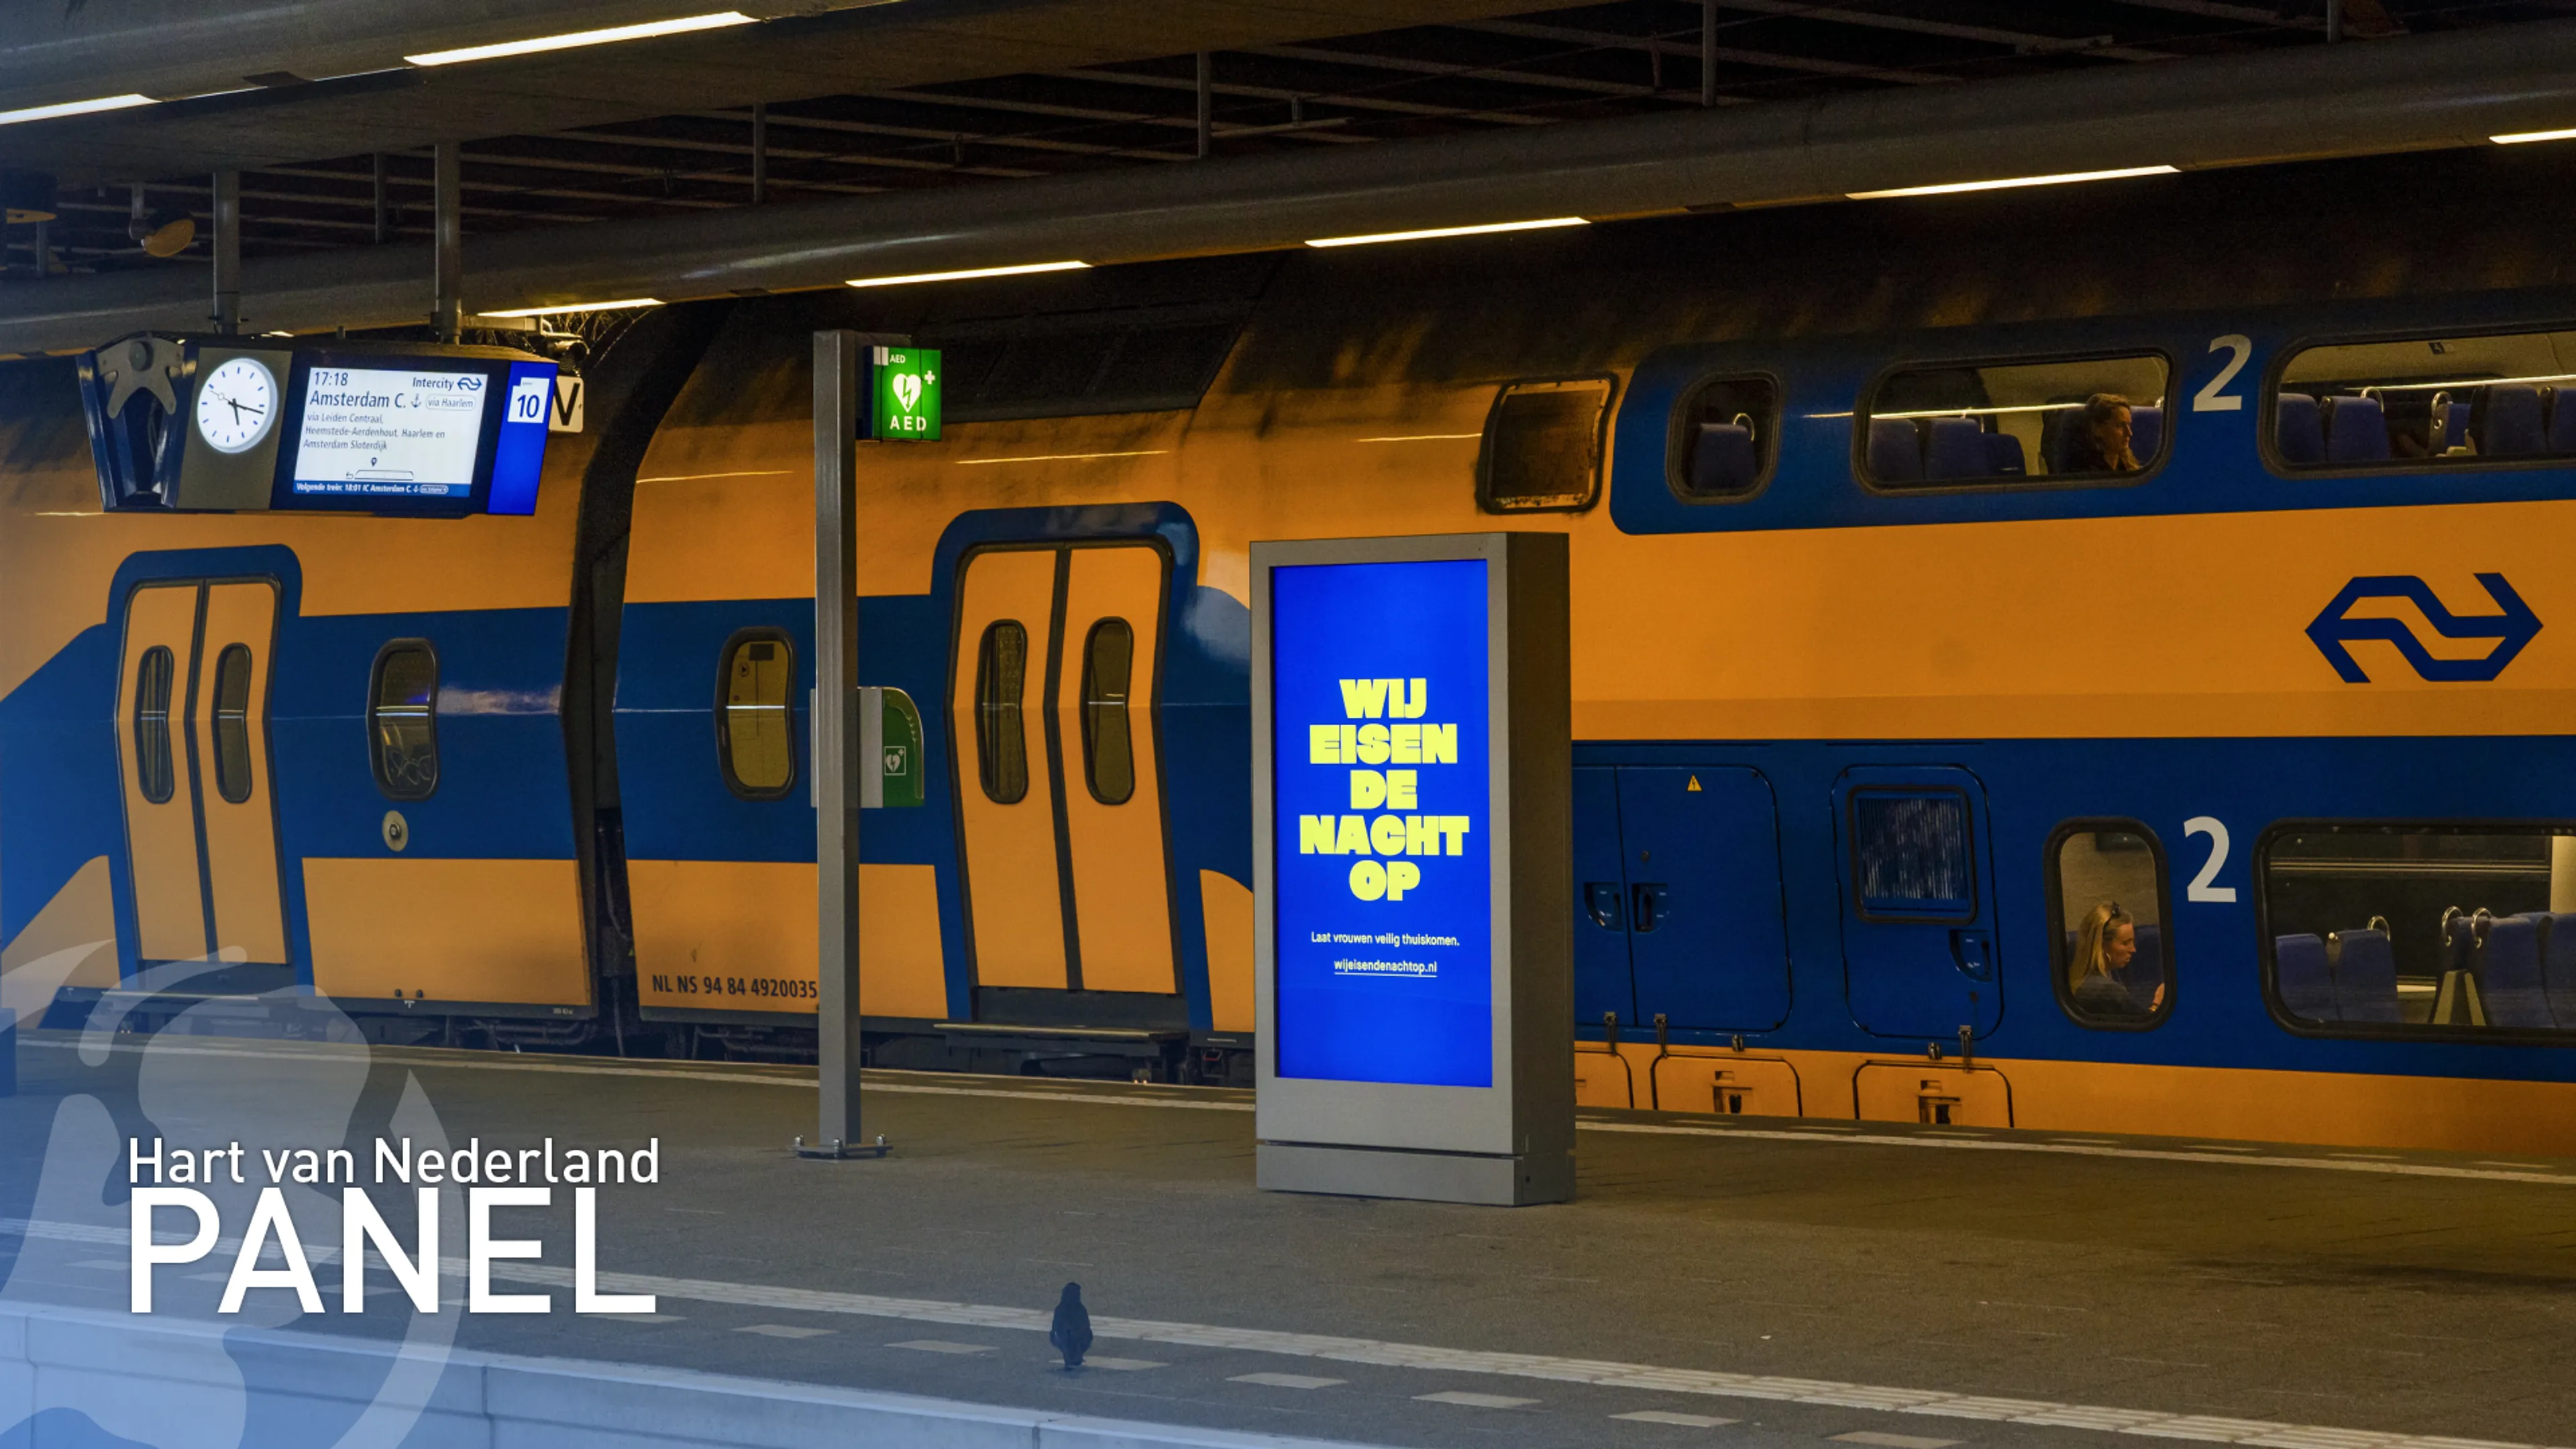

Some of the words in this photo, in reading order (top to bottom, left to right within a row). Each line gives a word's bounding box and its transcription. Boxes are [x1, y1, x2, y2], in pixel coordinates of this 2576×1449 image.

[890, 354, 906, 364] AED
[315, 372, 349, 386] 17:18
[2192, 334, 2252, 412] 2
[413, 376, 454, 391] Intercity
[309, 390, 390, 408] Amsterdam
[394, 392, 407, 409] C.
[428, 397, 439, 407] via
[441, 398, 474, 408] Haarlem
[517, 394, 540, 419] 10
[307, 412, 319, 421] via
[321, 412, 347, 422] Leiden
[890, 415, 927, 431] AED
[402, 428, 434, 439] Haarlem
[435, 431, 445, 439] en
[303, 439, 348, 449] Amsterdam
[350, 439, 388, 452] Sloterdijk
[1339, 678, 1427, 718] WIJ
[1309, 723, 1458, 765] EISEN
[1350, 769, 1417, 809] DE
[1299, 814, 1470, 856] NACHT
[2184, 815, 2237, 903] 2
[1349, 859, 1421, 901] OP
[1311, 931, 1332, 943] Laat
[1333, 933, 1373, 944] vrouwen
[1375, 932, 1400, 947] veilig
[1402, 933, 1460, 947] thuiskomen.
[1334, 958, 1438, 975] wijeisendenachtop.nl
[652, 975, 672, 992] NL
[677, 975, 698, 994] NS
[703, 977, 722, 994] 94
[727, 977, 746, 996] 84
[751, 979, 818, 998] 4920035
